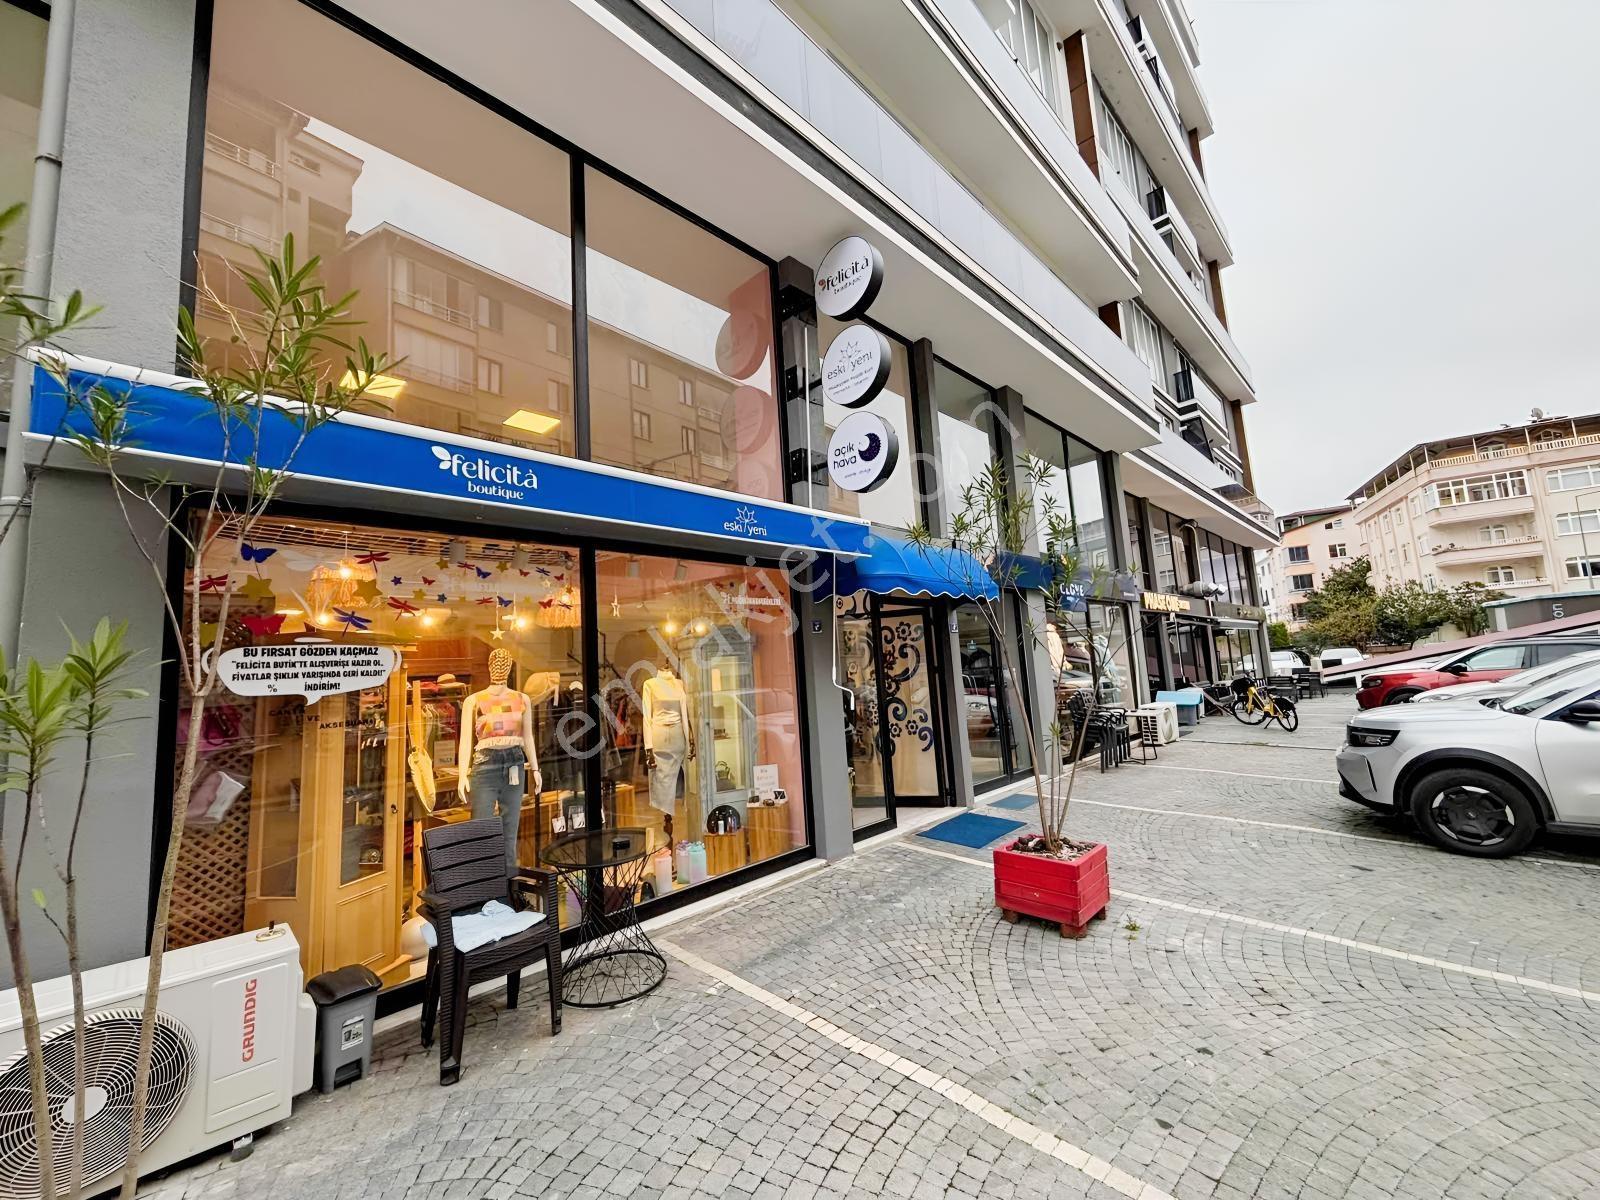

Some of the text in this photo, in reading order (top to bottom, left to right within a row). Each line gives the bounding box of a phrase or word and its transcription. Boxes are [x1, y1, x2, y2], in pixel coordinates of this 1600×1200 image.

[827, 365, 846, 380] eski
[850, 351, 873, 372] yeni
[834, 441, 855, 458] açık
[833, 455, 857, 470] hava
[451, 453, 538, 490] felicità
[467, 480, 524, 500] boutique
[723, 520, 767, 537] eski yeni
[243, 644, 379, 658] BU FIRSAT GÖZDEN KAÇMAZ
[231, 671, 272, 681] FİYATLAR
[273, 671, 299, 681] ŞIKLIK
[301, 671, 341, 680] YARIŞINDA
[342, 668, 359, 678] GERİ
[304, 680, 341, 692] İNDİRİM!
[242, 978, 257, 1062] GRUNDIG
